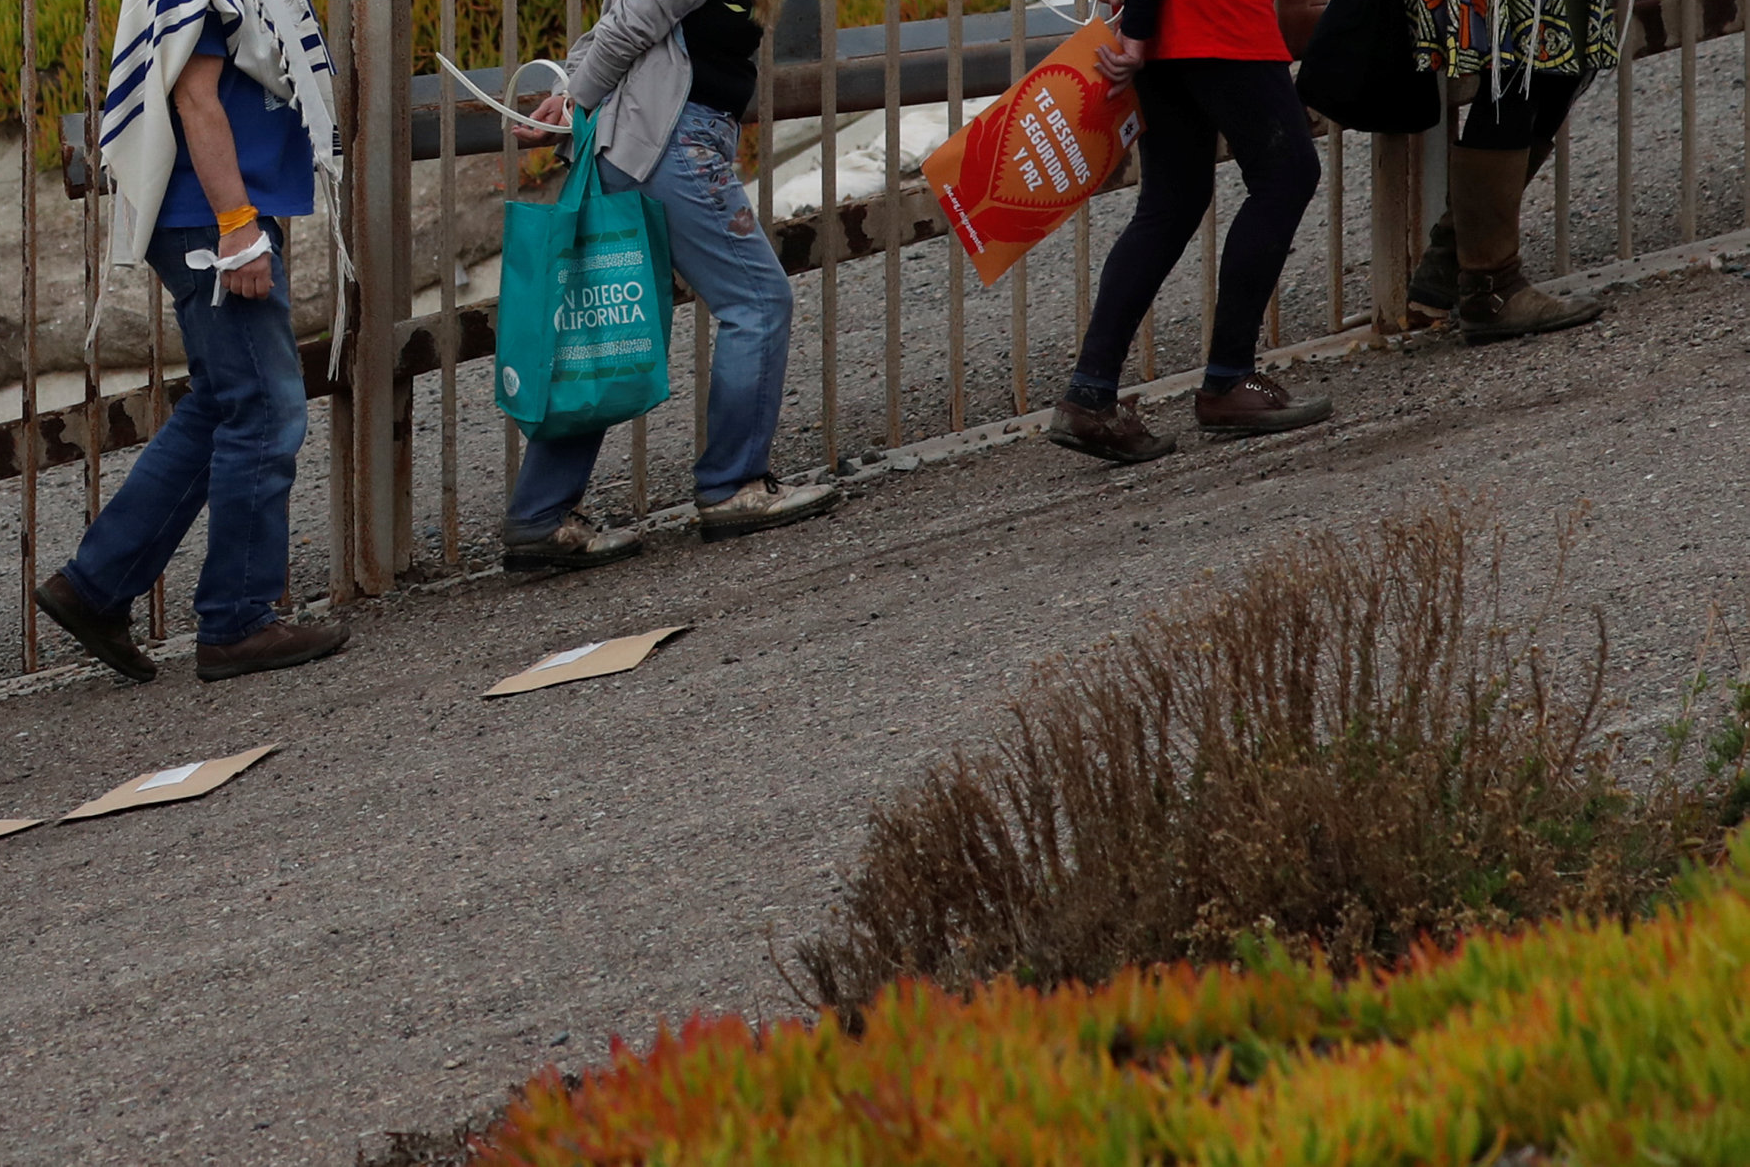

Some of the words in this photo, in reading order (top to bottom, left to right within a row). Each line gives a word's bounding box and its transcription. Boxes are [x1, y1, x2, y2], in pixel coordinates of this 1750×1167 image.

[1034, 87, 1055, 113] TE
[1046, 108, 1091, 185] DESEAMOS
[1013, 146, 1029, 162] Y
[1019, 112, 1070, 194] SEGURIDAD
[1019, 159, 1044, 192] PAZ
[582, 281, 643, 308] DIEGO
